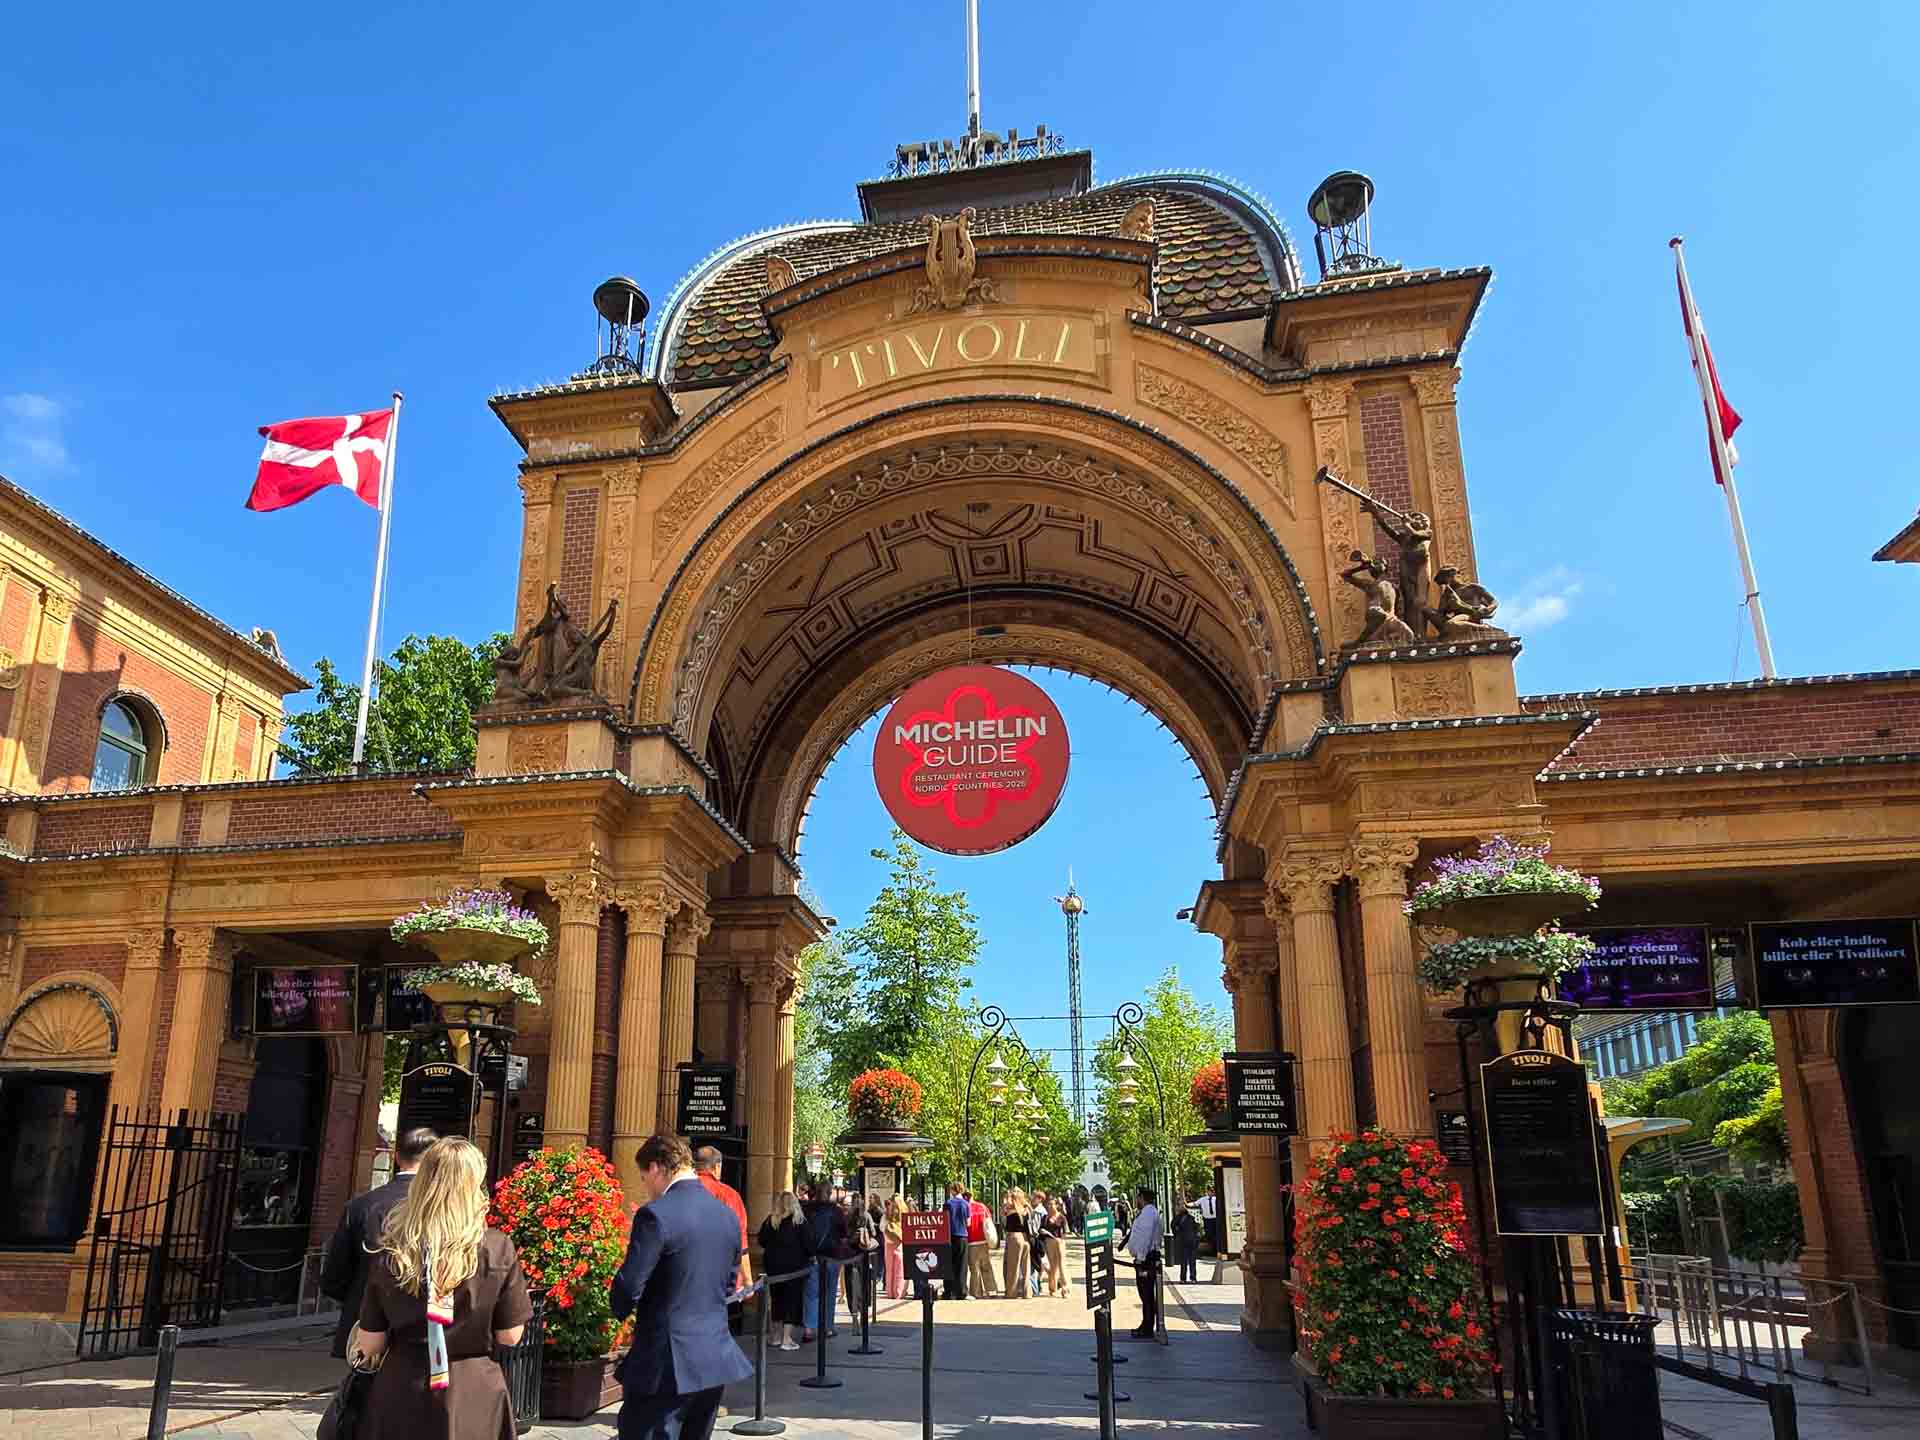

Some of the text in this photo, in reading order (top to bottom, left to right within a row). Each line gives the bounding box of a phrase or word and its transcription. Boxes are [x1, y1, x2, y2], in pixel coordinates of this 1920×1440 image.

[831, 319, 1073, 389] TIVOLI
[895, 716, 1047, 745] MICHELIN
[923, 742, 1017, 767] GUIDE
[915, 769, 1026, 783] RESTAURANT CEREMONY
[915, 784, 949, 793] NORDIC
[952, 781, 1003, 791] COUNTRIES
[1628, 942, 1678, 953] redeem
[1629, 955, 1666, 966] Tivoli
[1511, 1054, 1552, 1066] TIVOLI
[424, 1066, 453, 1076] TIVOLI
[907, 1215, 944, 1226] UDGANG
[915, 1229, 938, 1240] EXIT
